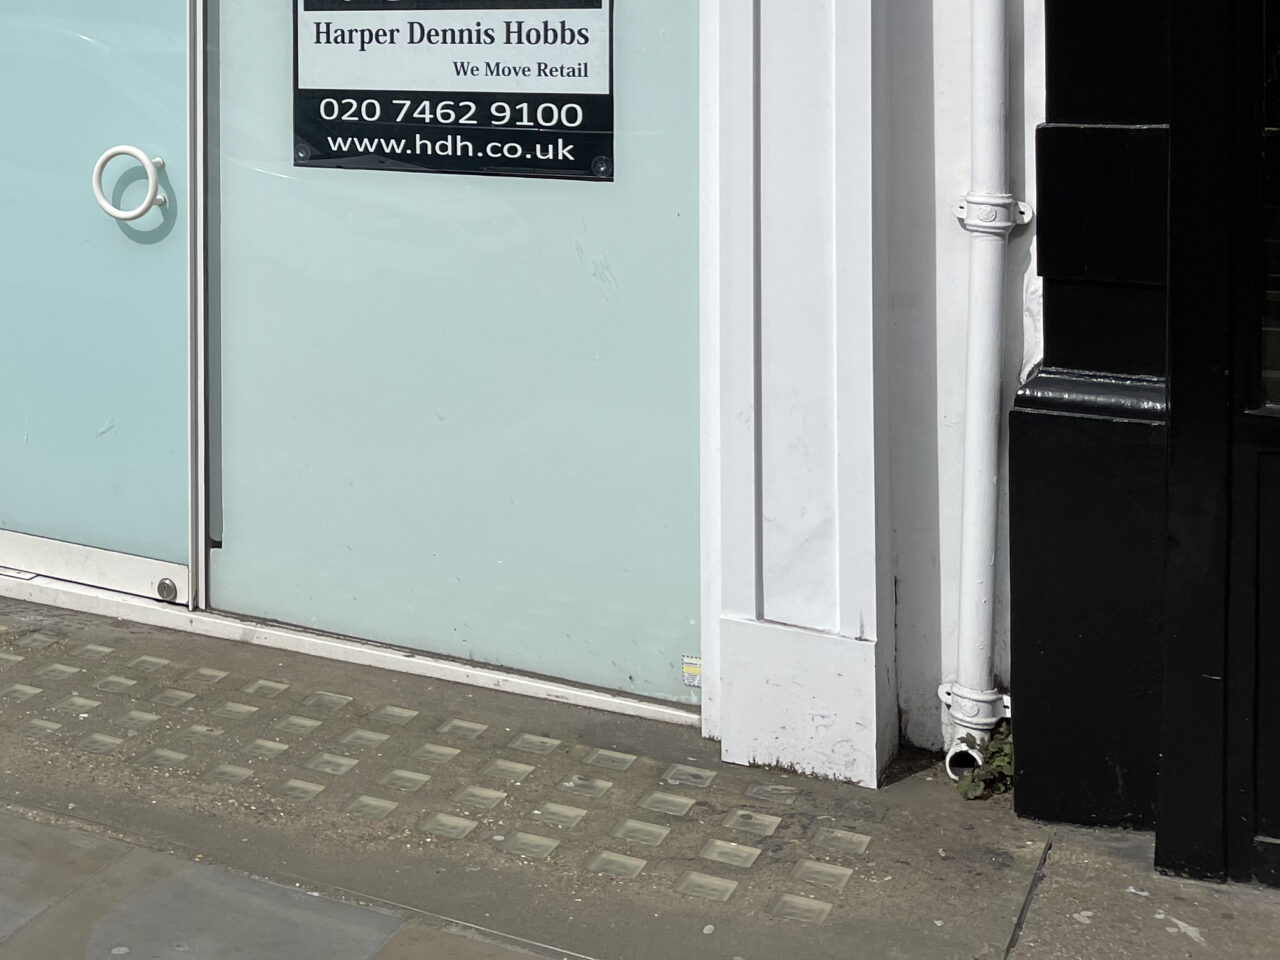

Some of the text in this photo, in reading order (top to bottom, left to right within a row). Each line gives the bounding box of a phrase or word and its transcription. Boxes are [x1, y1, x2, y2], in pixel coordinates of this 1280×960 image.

[313, 20, 590, 51] Harper Dennis Hobbs
[452, 61, 589, 78] We Move Retail
[319, 98, 583, 127] 020 7462 9100
[326, 134, 575, 161] www.hdh.co.uk
